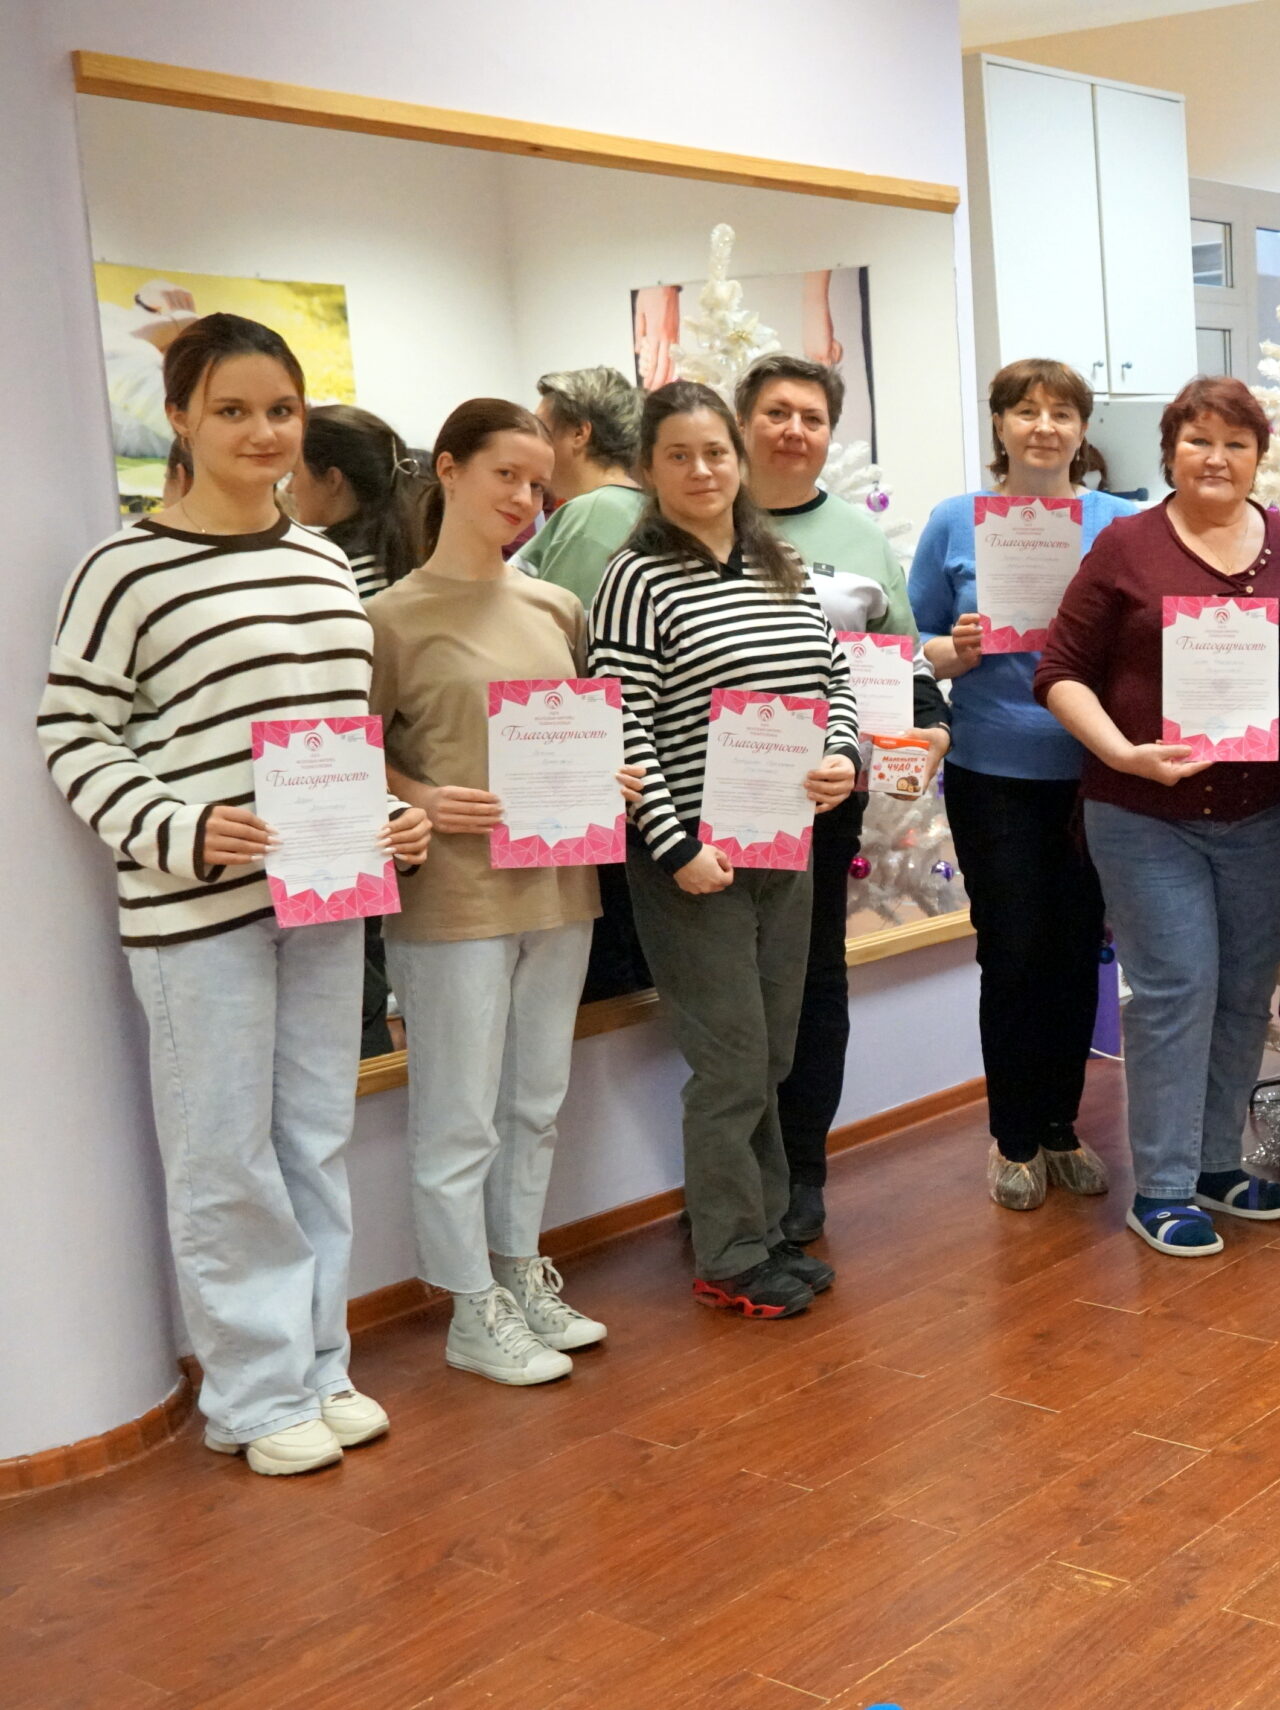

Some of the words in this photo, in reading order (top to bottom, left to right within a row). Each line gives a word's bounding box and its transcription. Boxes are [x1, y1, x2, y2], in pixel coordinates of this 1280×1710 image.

[985, 533, 1070, 551] Благодарность
[1176, 635, 1267, 654] Благодарность
[501, 724, 608, 745] Благодарность
[717, 731, 809, 755] Благодарность
[887, 763, 911, 771] ЧУДО
[265, 769, 370, 790] Благодарность
